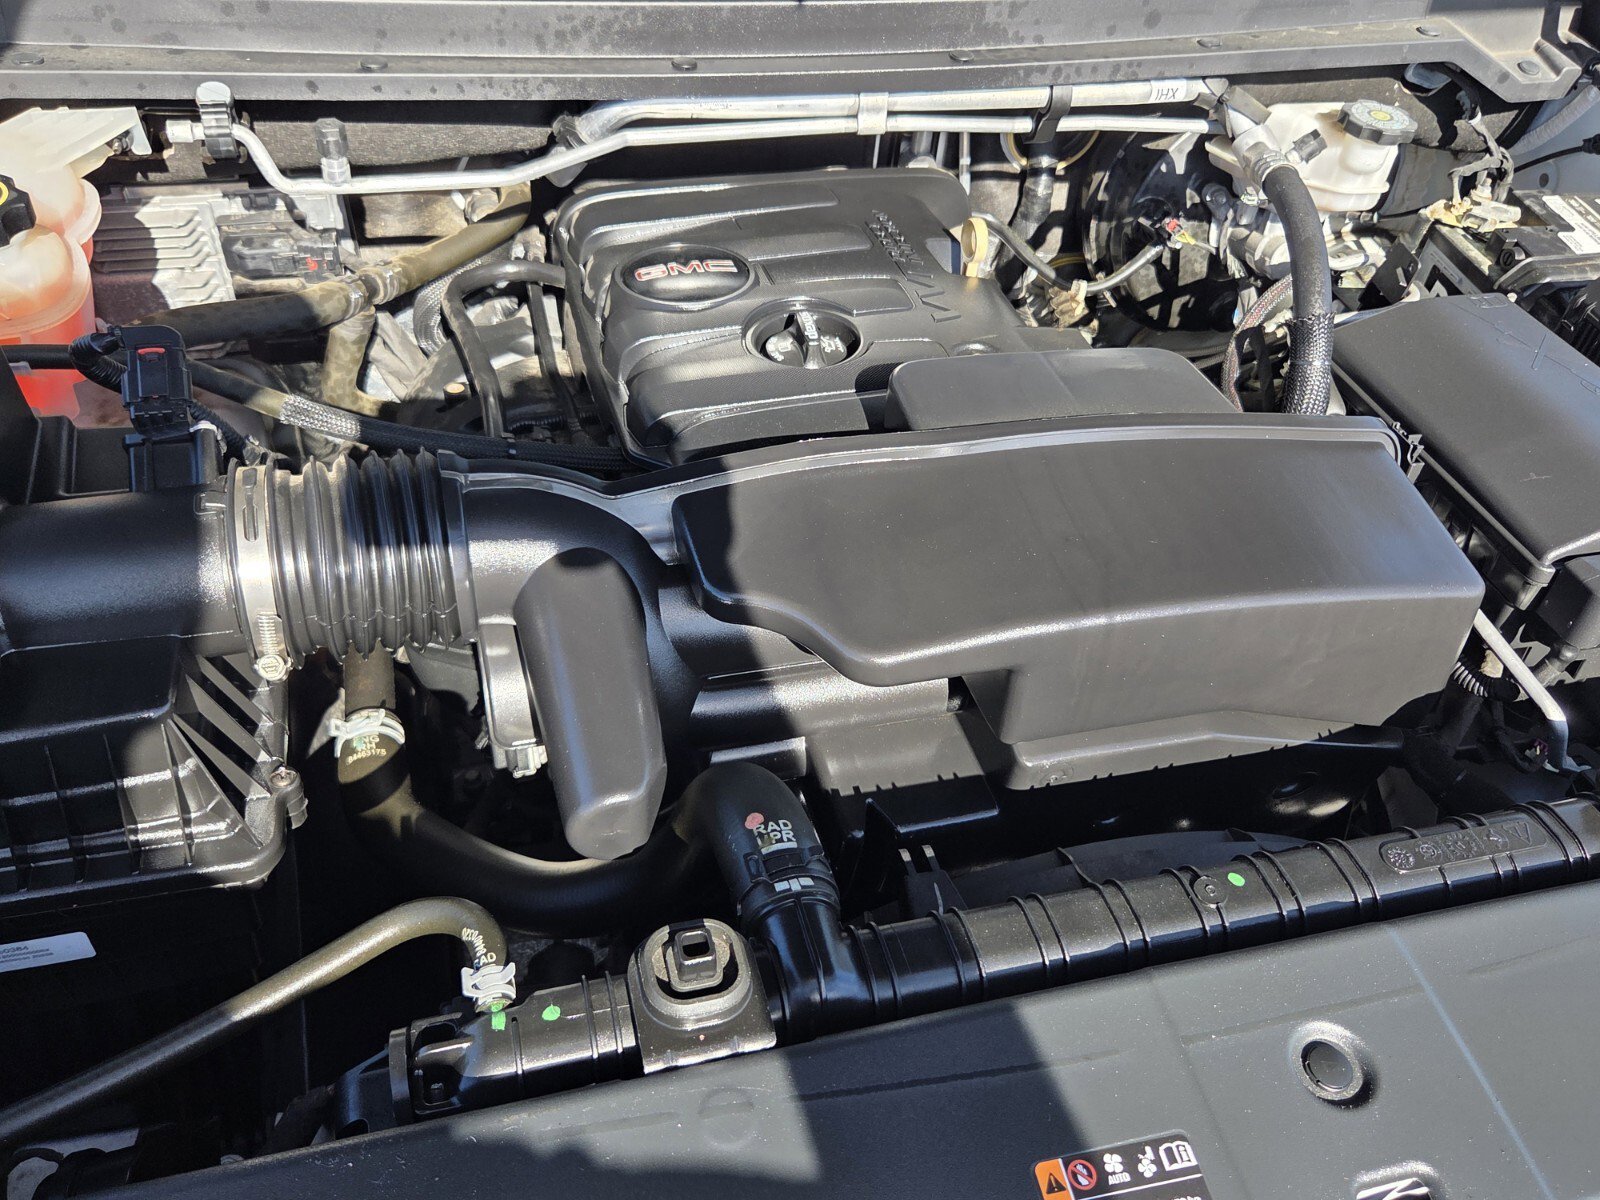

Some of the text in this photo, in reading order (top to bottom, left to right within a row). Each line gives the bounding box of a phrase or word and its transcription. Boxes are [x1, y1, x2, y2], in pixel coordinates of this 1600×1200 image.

[634, 259, 739, 282] GMC
[752, 819, 793, 836] RAD
[1107, 1172, 1131, 1186] AUTO
